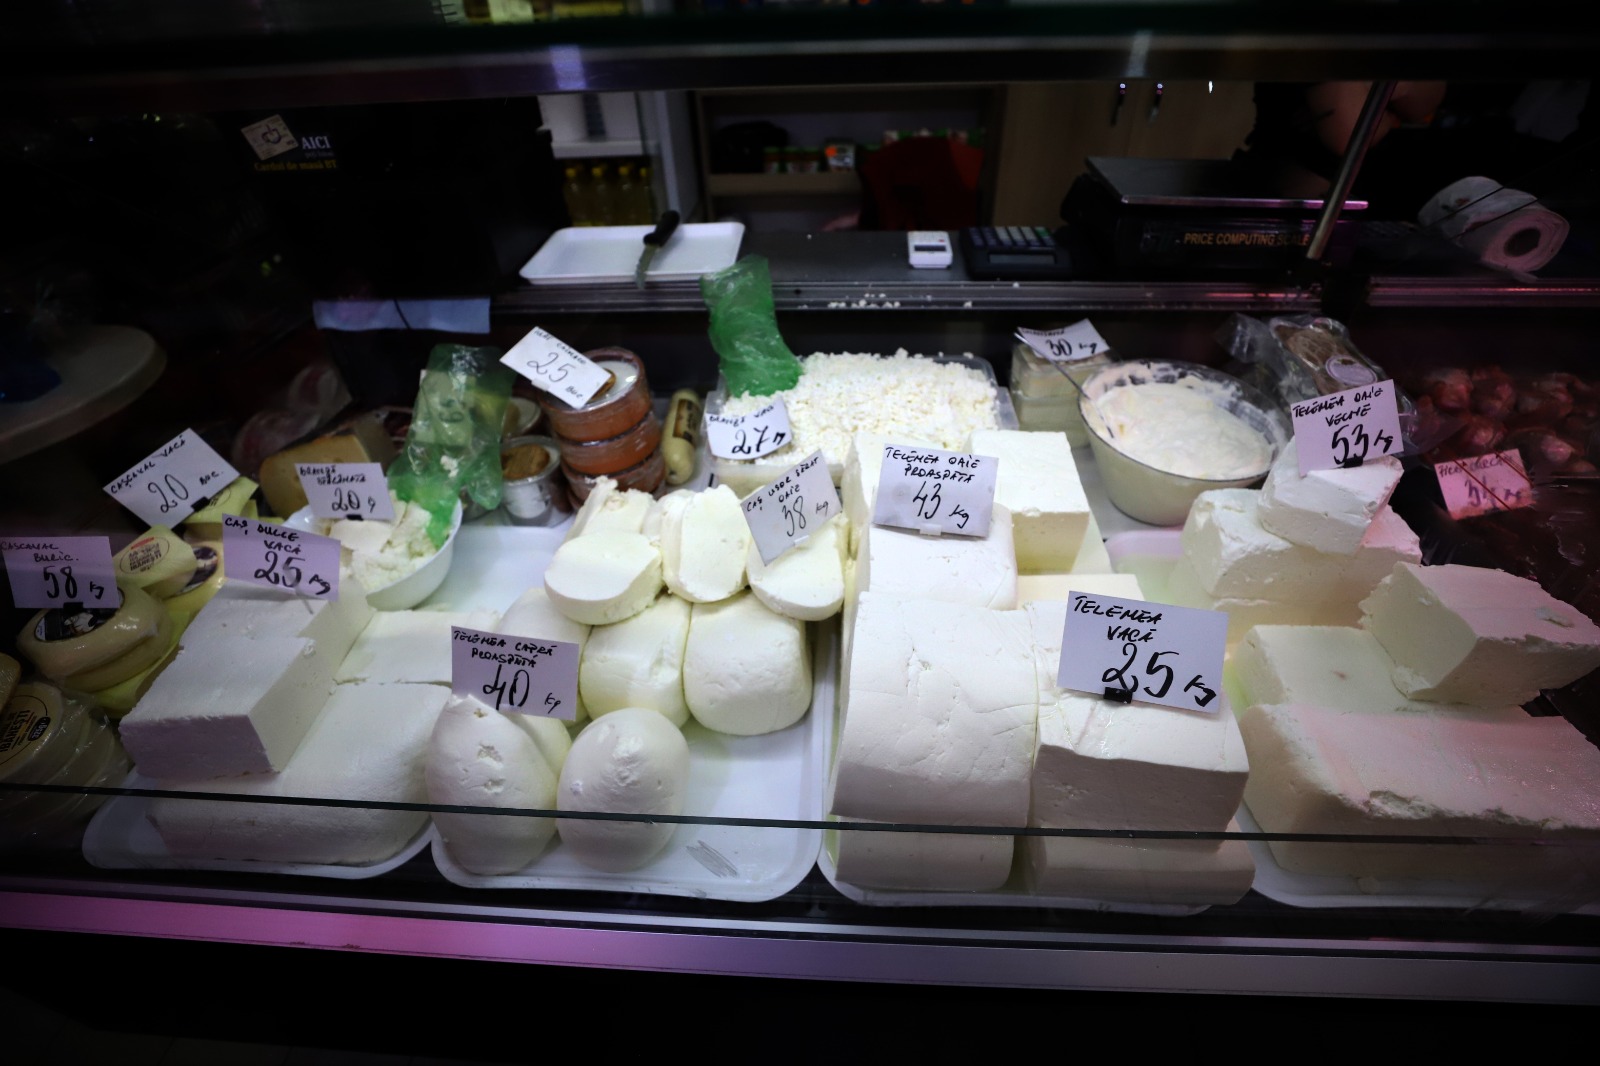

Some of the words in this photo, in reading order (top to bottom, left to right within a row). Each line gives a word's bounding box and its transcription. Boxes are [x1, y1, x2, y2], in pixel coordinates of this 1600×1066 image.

[301, 135, 332, 150] AICI
[1184, 232, 1214, 246] PRICE
[1216, 232, 1276, 246] COMPUTING
[527, 352, 577, 383] 25
[731, 425, 771, 454] 27
[1331, 424, 1369, 465] 53
[148, 474, 189, 513] 20
[332, 487, 360, 511] 20
[912, 480, 942, 520] 43
[257, 524, 299, 541] DULCE
[782, 495, 807, 537] 38
[43, 565, 78, 598] 58
[254, 550, 306, 588] 25
[1074, 595, 1162, 624] TELEMEA
[1101, 642, 1179, 698] 25
[482, 664, 530, 711] 40
